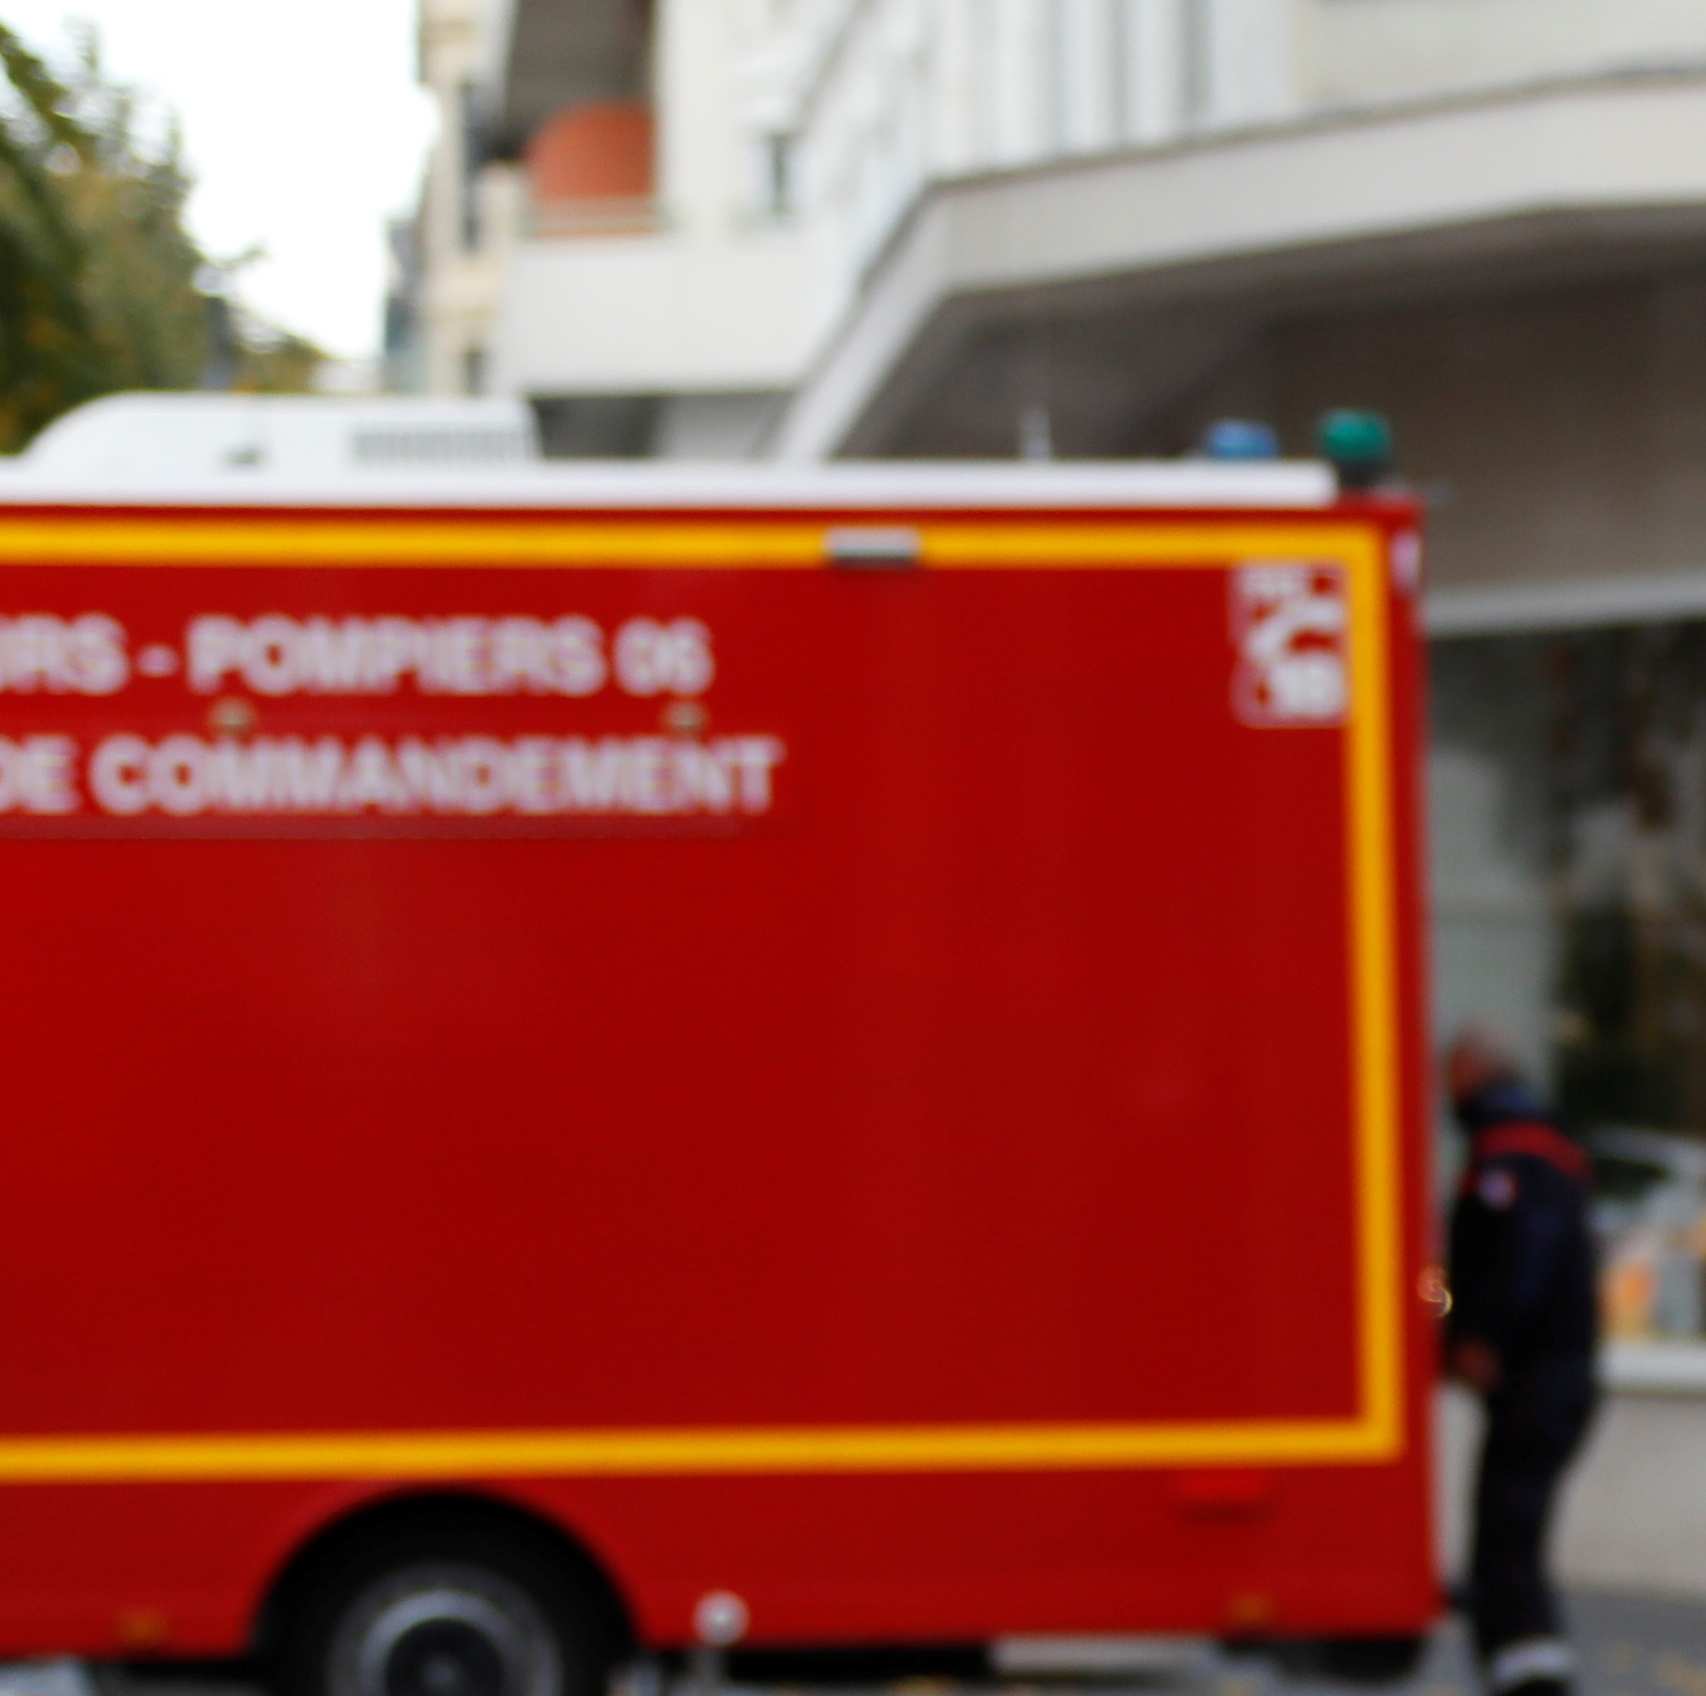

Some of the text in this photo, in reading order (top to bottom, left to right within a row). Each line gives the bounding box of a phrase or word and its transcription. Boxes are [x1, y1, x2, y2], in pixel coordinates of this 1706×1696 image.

[0, 612, 130, 696] RS
[186, 614, 606, 696] POMPIERS
[88, 735, 786, 816] COMMANDEMENT
